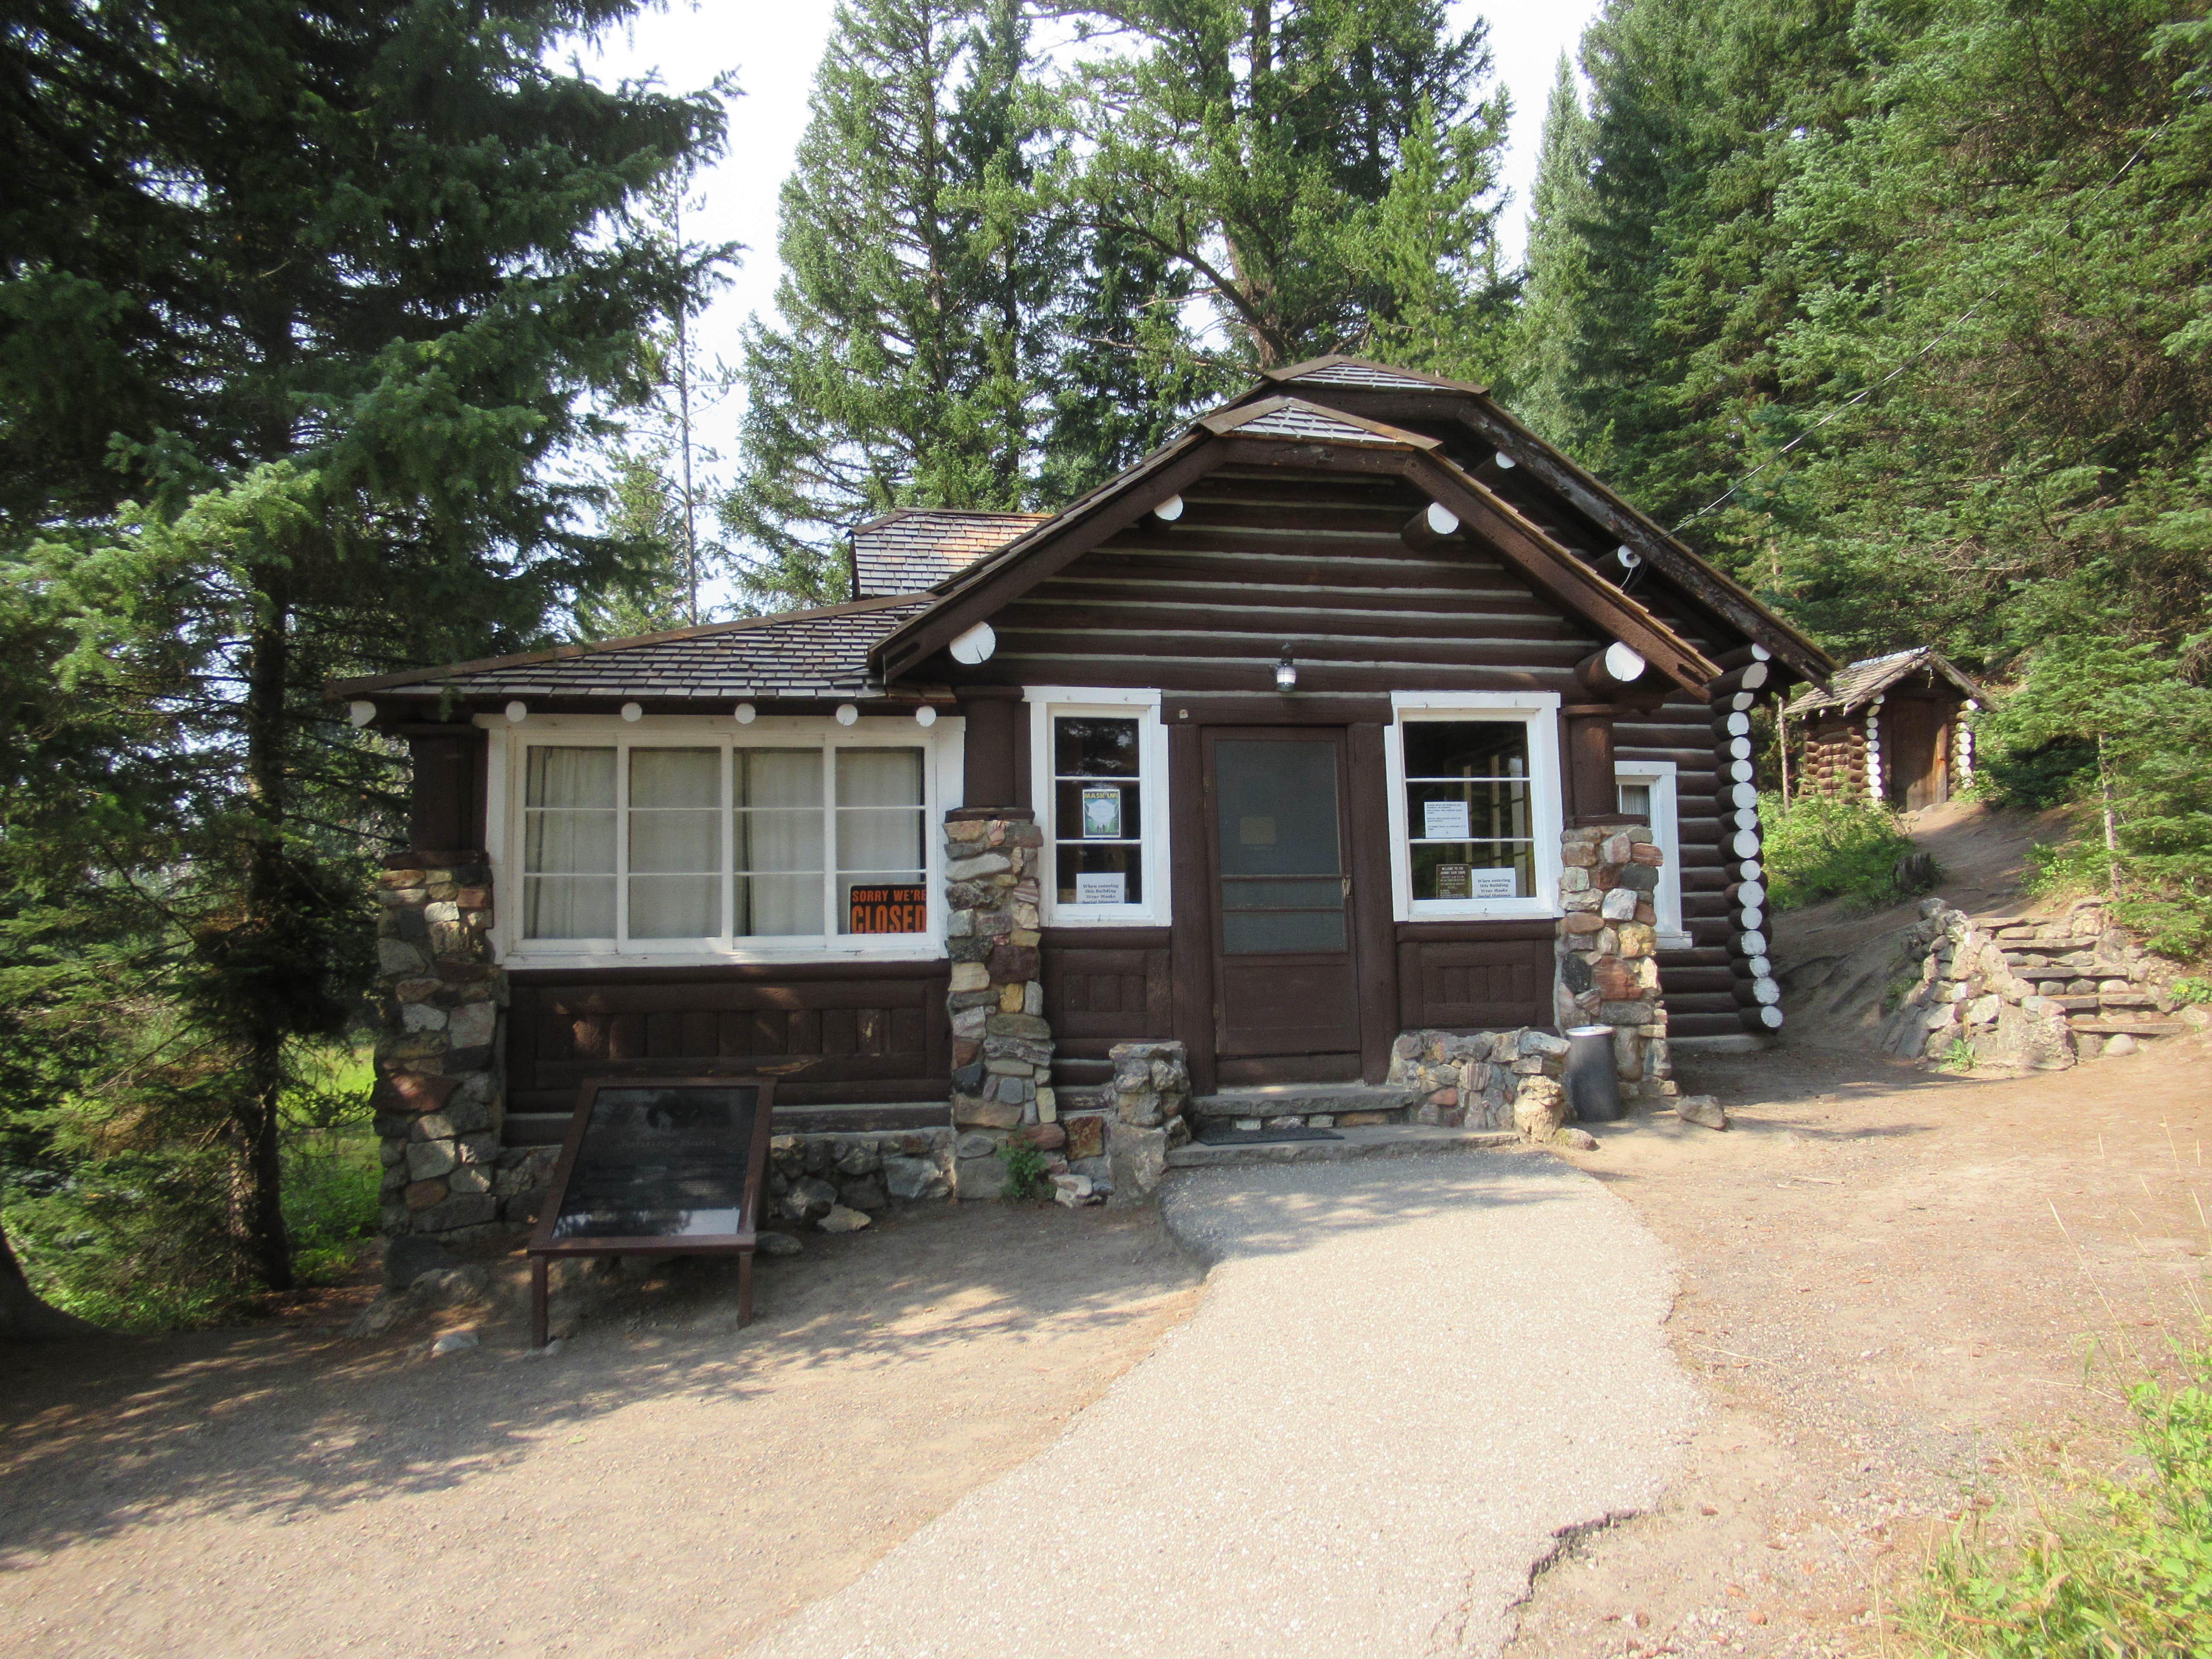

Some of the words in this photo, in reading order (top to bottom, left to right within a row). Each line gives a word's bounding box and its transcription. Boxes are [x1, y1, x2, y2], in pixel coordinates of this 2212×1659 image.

[852, 890, 889, 902] SORRY
[893, 889, 926, 901] WE'RE
[852, 905, 926, 934] CLOSED
